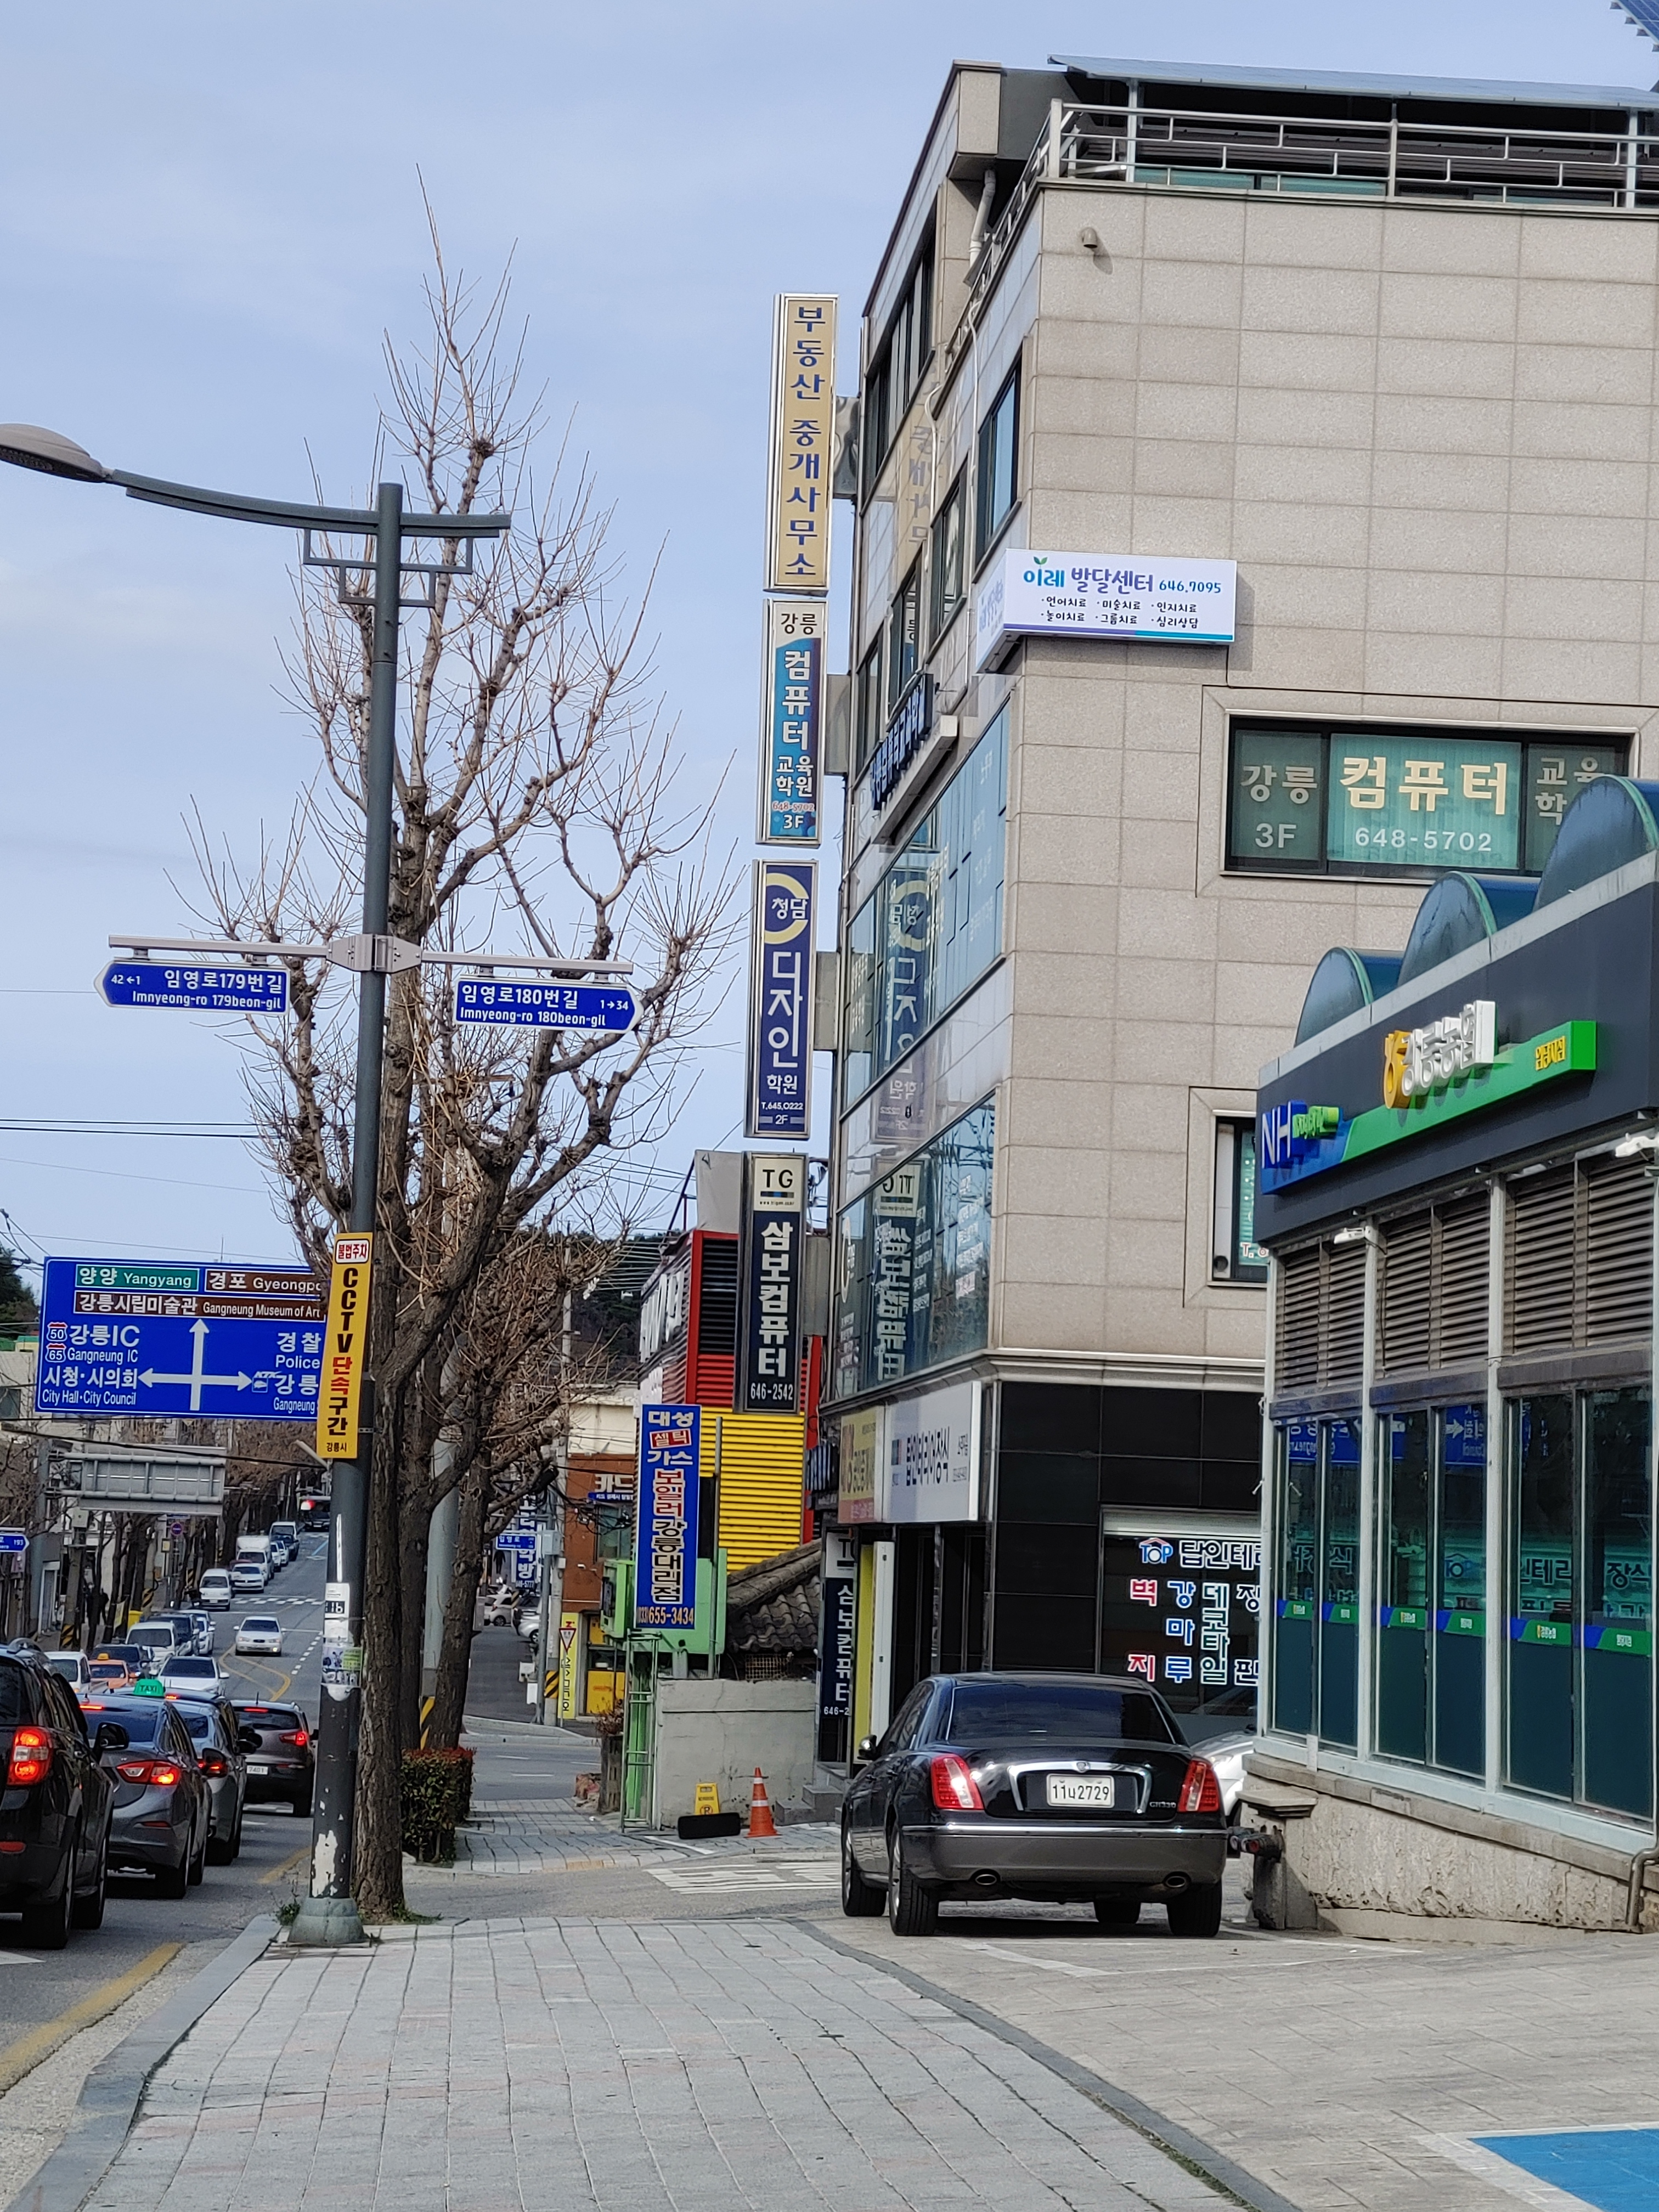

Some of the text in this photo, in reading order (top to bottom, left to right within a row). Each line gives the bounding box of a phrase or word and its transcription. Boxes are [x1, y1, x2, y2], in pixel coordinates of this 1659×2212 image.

[785, 306, 826, 575] 부동산 중개사무소
[1071, 567, 1154, 595] 발달센터
[1046, 596, 1197, 613] 언어치료 미술치료 인지치료
[781, 613, 818, 635] 강릉
[1046, 610, 1199, 629] 놀이치료 그룹치료 심리상담
[782, 651, 811, 751] 컴퓨터
[775, 755, 814, 776] 교육
[775, 775, 813, 798] 학원
[1240, 764, 1318, 805] 강릉
[1340, 755, 1506, 816] 컴퓨터
[772, 802, 815, 812] 648-5702
[783, 815, 804, 829] 3F
[1255, 823, 1297, 849] 3F
[1355, 827, 1493, 852] 648-5702
[771, 898, 808, 920] 청담
[111, 975, 124, 984] 42
[164, 969, 283, 994] 임영로179번길
[132, 990, 282, 1011] Imnyeong-ro 179beon-gil
[462, 984, 578, 1009] 임영로180번길
[616, 1001, 629, 1011] 34
[460, 1007, 606, 1027] Imnyeong-ro 180beon-gil
[768, 951, 803, 1068] 디자인
[766, 1074, 798, 1095] 학원
[775, 1115, 788, 1125] 2F
[1261, 1101, 1293, 1169] NH
[763, 1169, 793, 1188] TG
[337, 1243, 368, 1260] 불법주차
[79, 1267, 117, 1285] 양양
[123, 1272, 191, 1289] Yangyang
[209, 1272, 247, 1290] 경포
[79, 1293, 198, 1316] 강릉시립미술관
[203, 1302, 253, 1317] Gangneung
[256, 1304, 293, 1317] Museum
[295, 1305, 304, 1317] of
[758, 1222, 793, 1378] 삼보컴퓨터
[50, 1324, 140, 1347] 50 강릉IC
[276, 1331, 322, 1353] 경찰
[49, 1347, 138, 1365] 65 Gangneung IC
[275, 1354, 320, 1369] Police
[275, 1374, 319, 1396] 강릉
[750, 1383, 794, 1401] 646-2542
[42, 1389, 60, 1406] City
[103, 1391, 137, 1405] Council
[273, 1397, 315, 1414] Gangneung
[648, 1410, 694, 1427] 대성
[326, 1442, 347, 1453] 강릉시
[647, 1451, 693, 1466] 가스
[595, 1474, 634, 1493] 카드
[654, 1469, 685, 1518] 보일러
[1200, 1582, 1230, 1685] 데코타일
